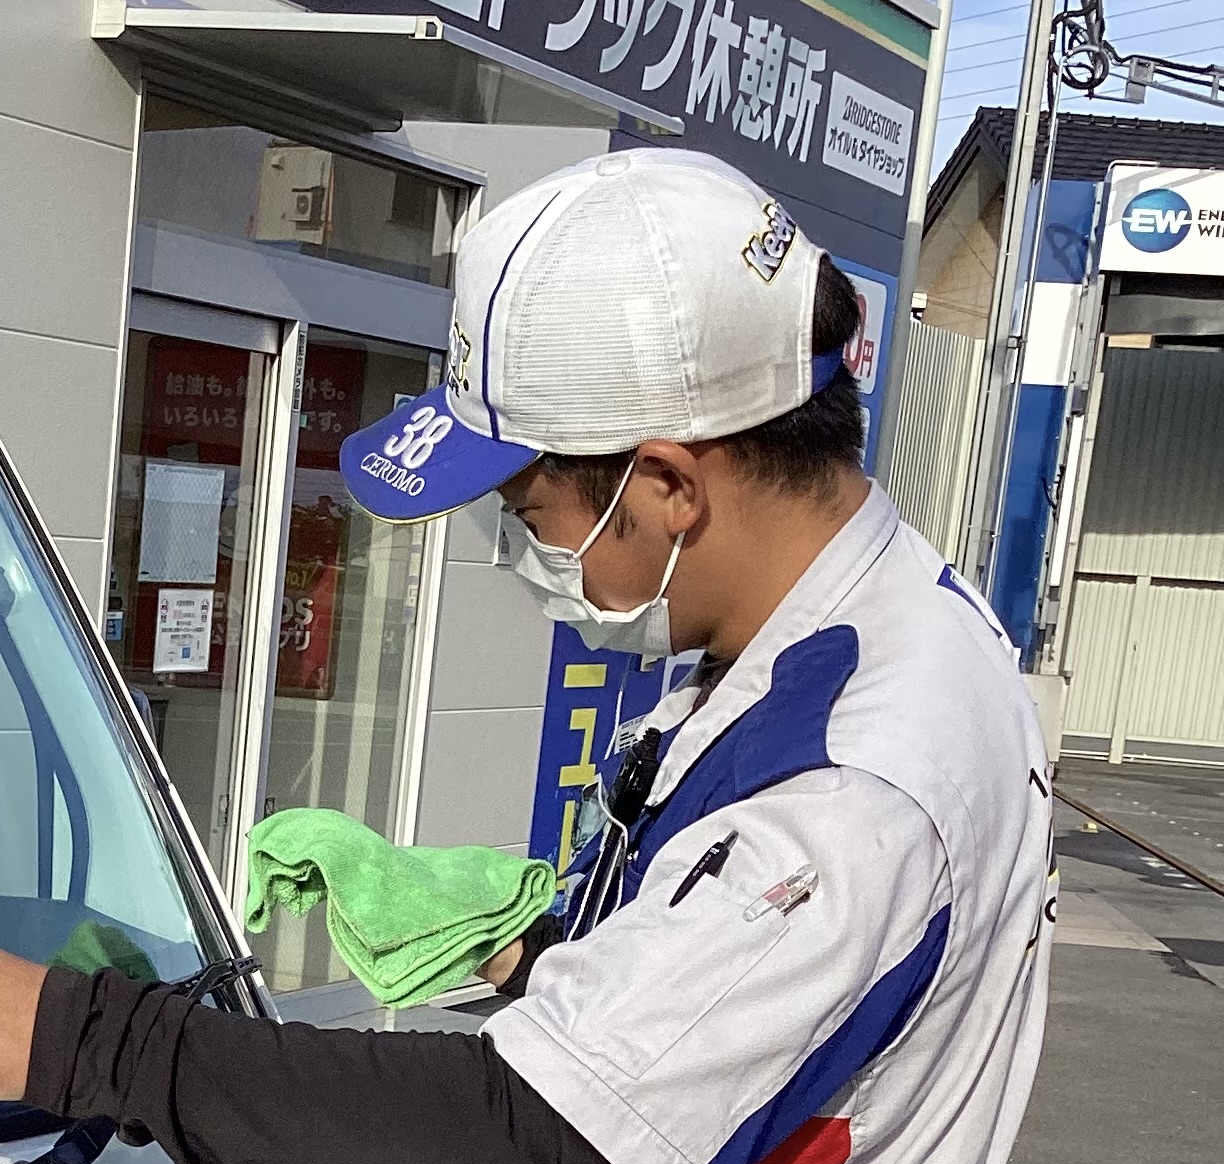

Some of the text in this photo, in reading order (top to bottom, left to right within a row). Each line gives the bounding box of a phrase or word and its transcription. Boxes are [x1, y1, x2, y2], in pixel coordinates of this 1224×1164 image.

[842, 95, 903, 145] BRIDGESTONE
[1129, 208, 1188, 235] EW
[1197, 223, 1224, 238] WI
[384, 406, 454, 470] 38
[360, 452, 427, 497] CERUMO
